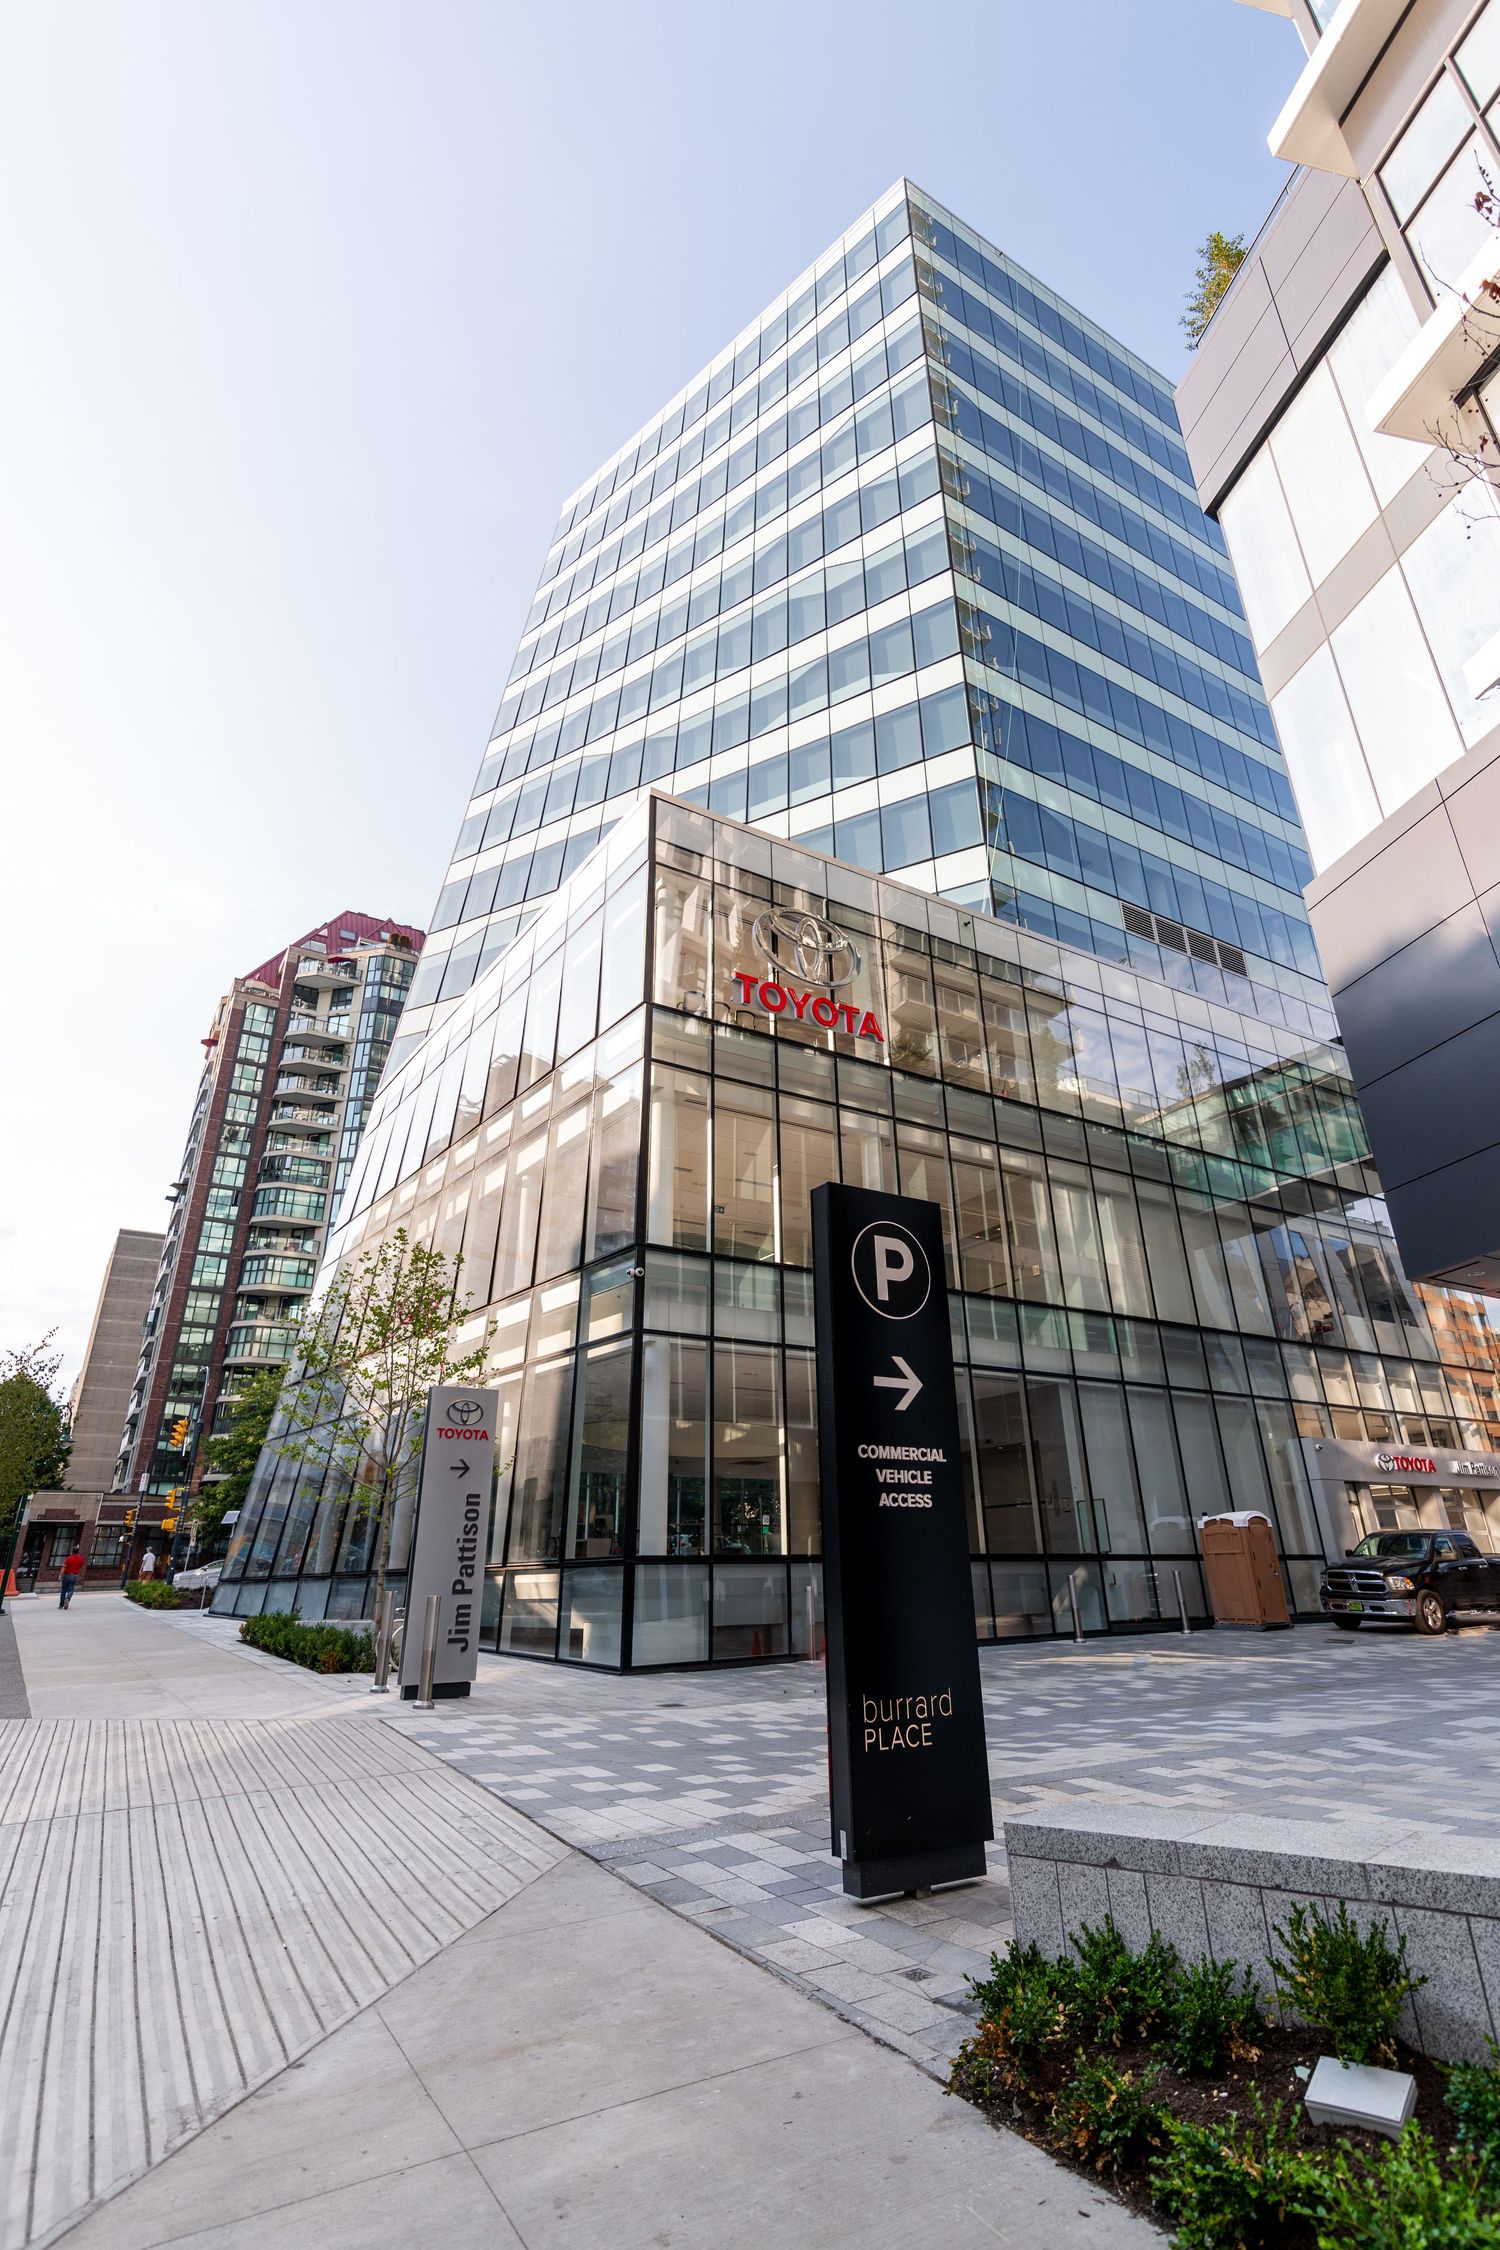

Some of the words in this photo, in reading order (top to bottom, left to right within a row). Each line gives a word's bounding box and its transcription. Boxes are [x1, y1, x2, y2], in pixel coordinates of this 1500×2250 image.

[732, 971, 884, 1043] TOYOTA
[873, 1235, 914, 1301] P
[437, 1427, 489, 1441] TOYOTA
[857, 1444, 947, 1463] COMMERCIAL
[1392, 1455, 1437, 1473] TOYOTA
[876, 1468, 932, 1485] VEHICLE
[1456, 1461, 1471, 1475] Jim
[879, 1493, 933, 1508] ACCESS
[452, 1493, 481, 1596] Pattison
[447, 1604, 472, 1653] Jim
[863, 1688, 953, 1724] burrard
[864, 1722, 933, 1753] PLACE
